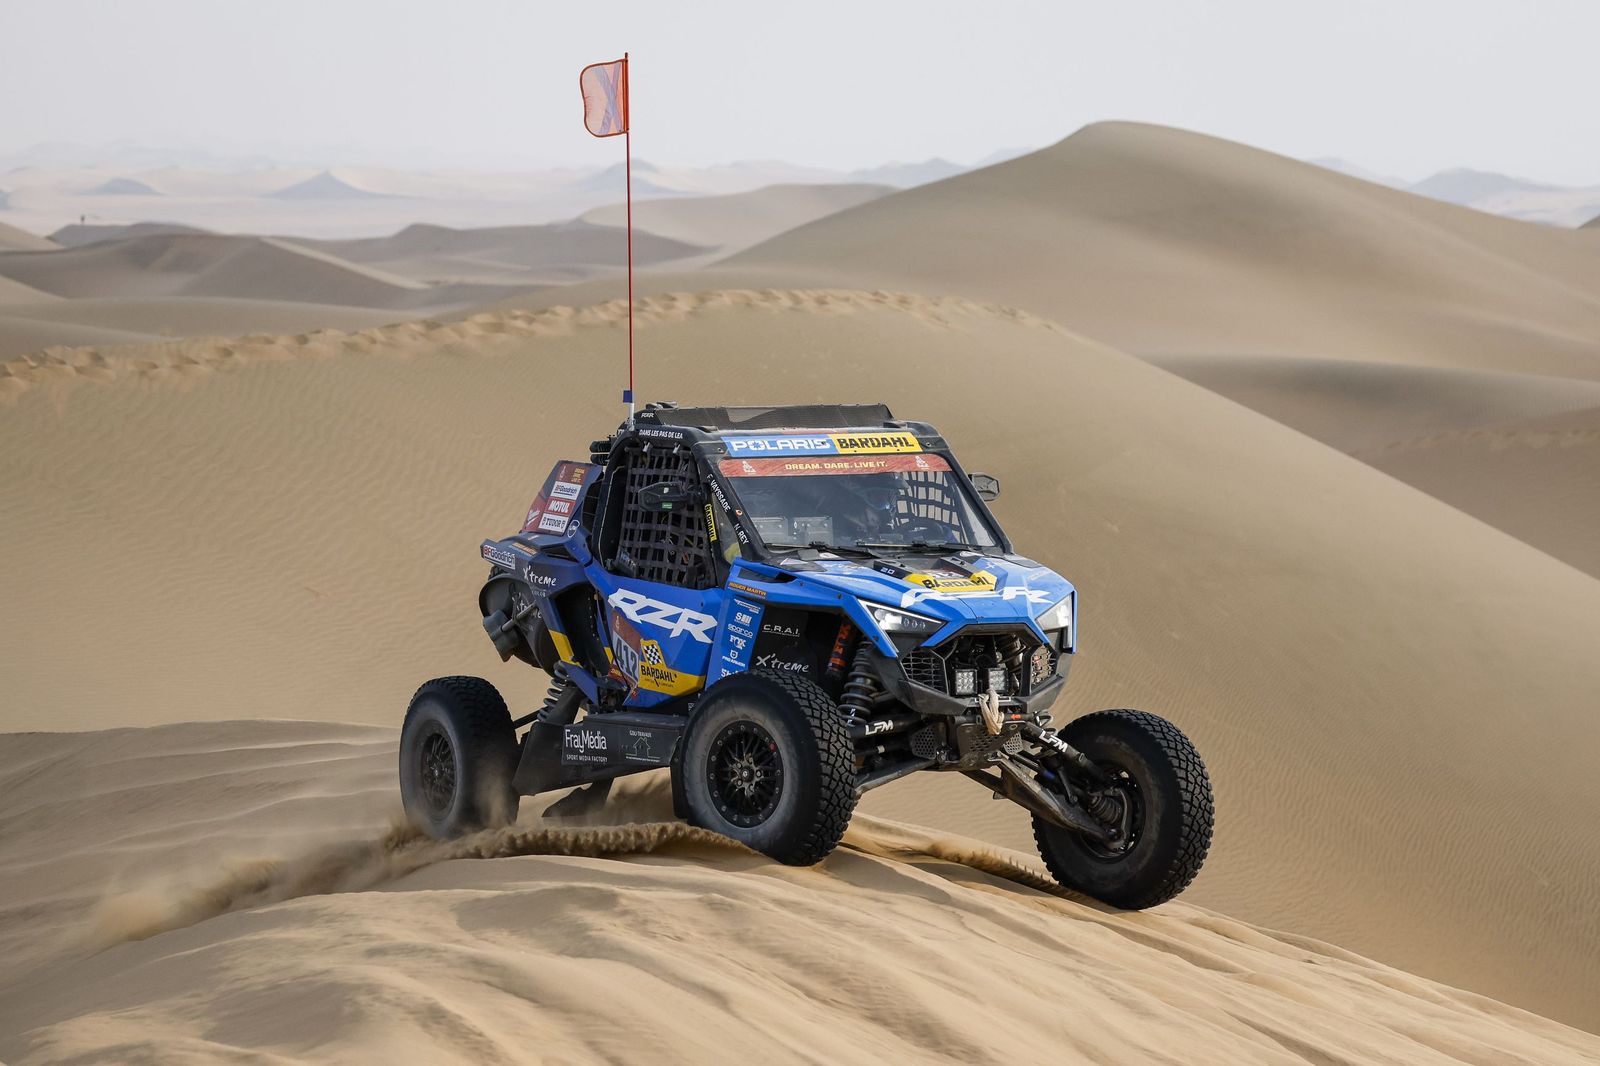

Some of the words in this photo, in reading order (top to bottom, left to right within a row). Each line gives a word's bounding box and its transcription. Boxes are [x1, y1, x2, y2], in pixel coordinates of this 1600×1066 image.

[732, 438, 831, 452] POLARIS
[837, 436, 915, 449] BARDAHL
[710, 479, 732, 513] VAYSSADE
[547, 500, 571, 513] MOTUL
[546, 518, 562, 528] TUDOR
[738, 530, 750, 545] REY
[483, 545, 516, 565] BFGoodrich
[921, 576, 995, 589] BARDAHL
[608, 588, 718, 644] RZR
[729, 634, 746, 649] FOX
[616, 637, 638, 682] 412
[640, 664, 676, 683] BARDAHL
[864, 719, 894, 735] LFM
[564, 728, 608, 753] FrayMédia
[1039, 730, 1068, 753] LFM
[591, 755, 608, 763] FACTORY
